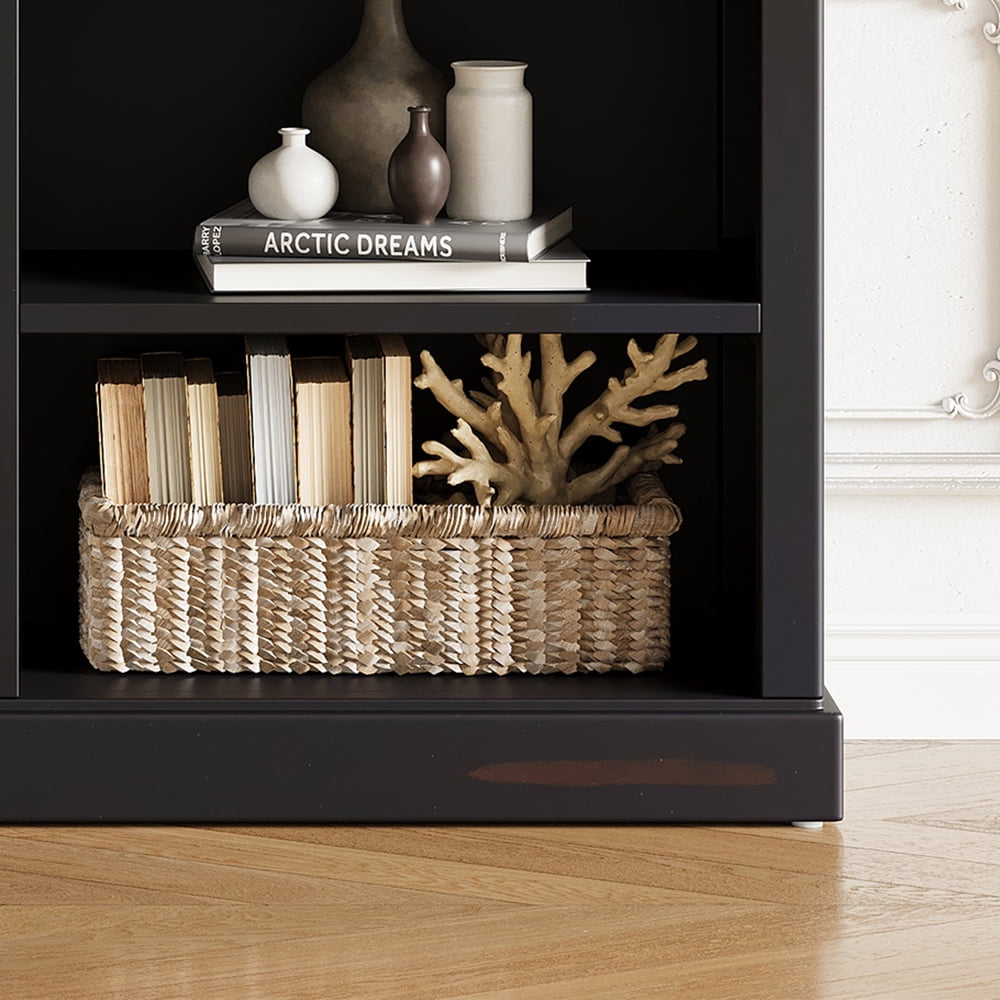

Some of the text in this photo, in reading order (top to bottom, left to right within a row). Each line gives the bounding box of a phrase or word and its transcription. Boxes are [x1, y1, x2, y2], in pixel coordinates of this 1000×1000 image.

[212, 226, 222, 255] OPEZ
[264, 231, 453, 258] ARCTIC DREAMS
